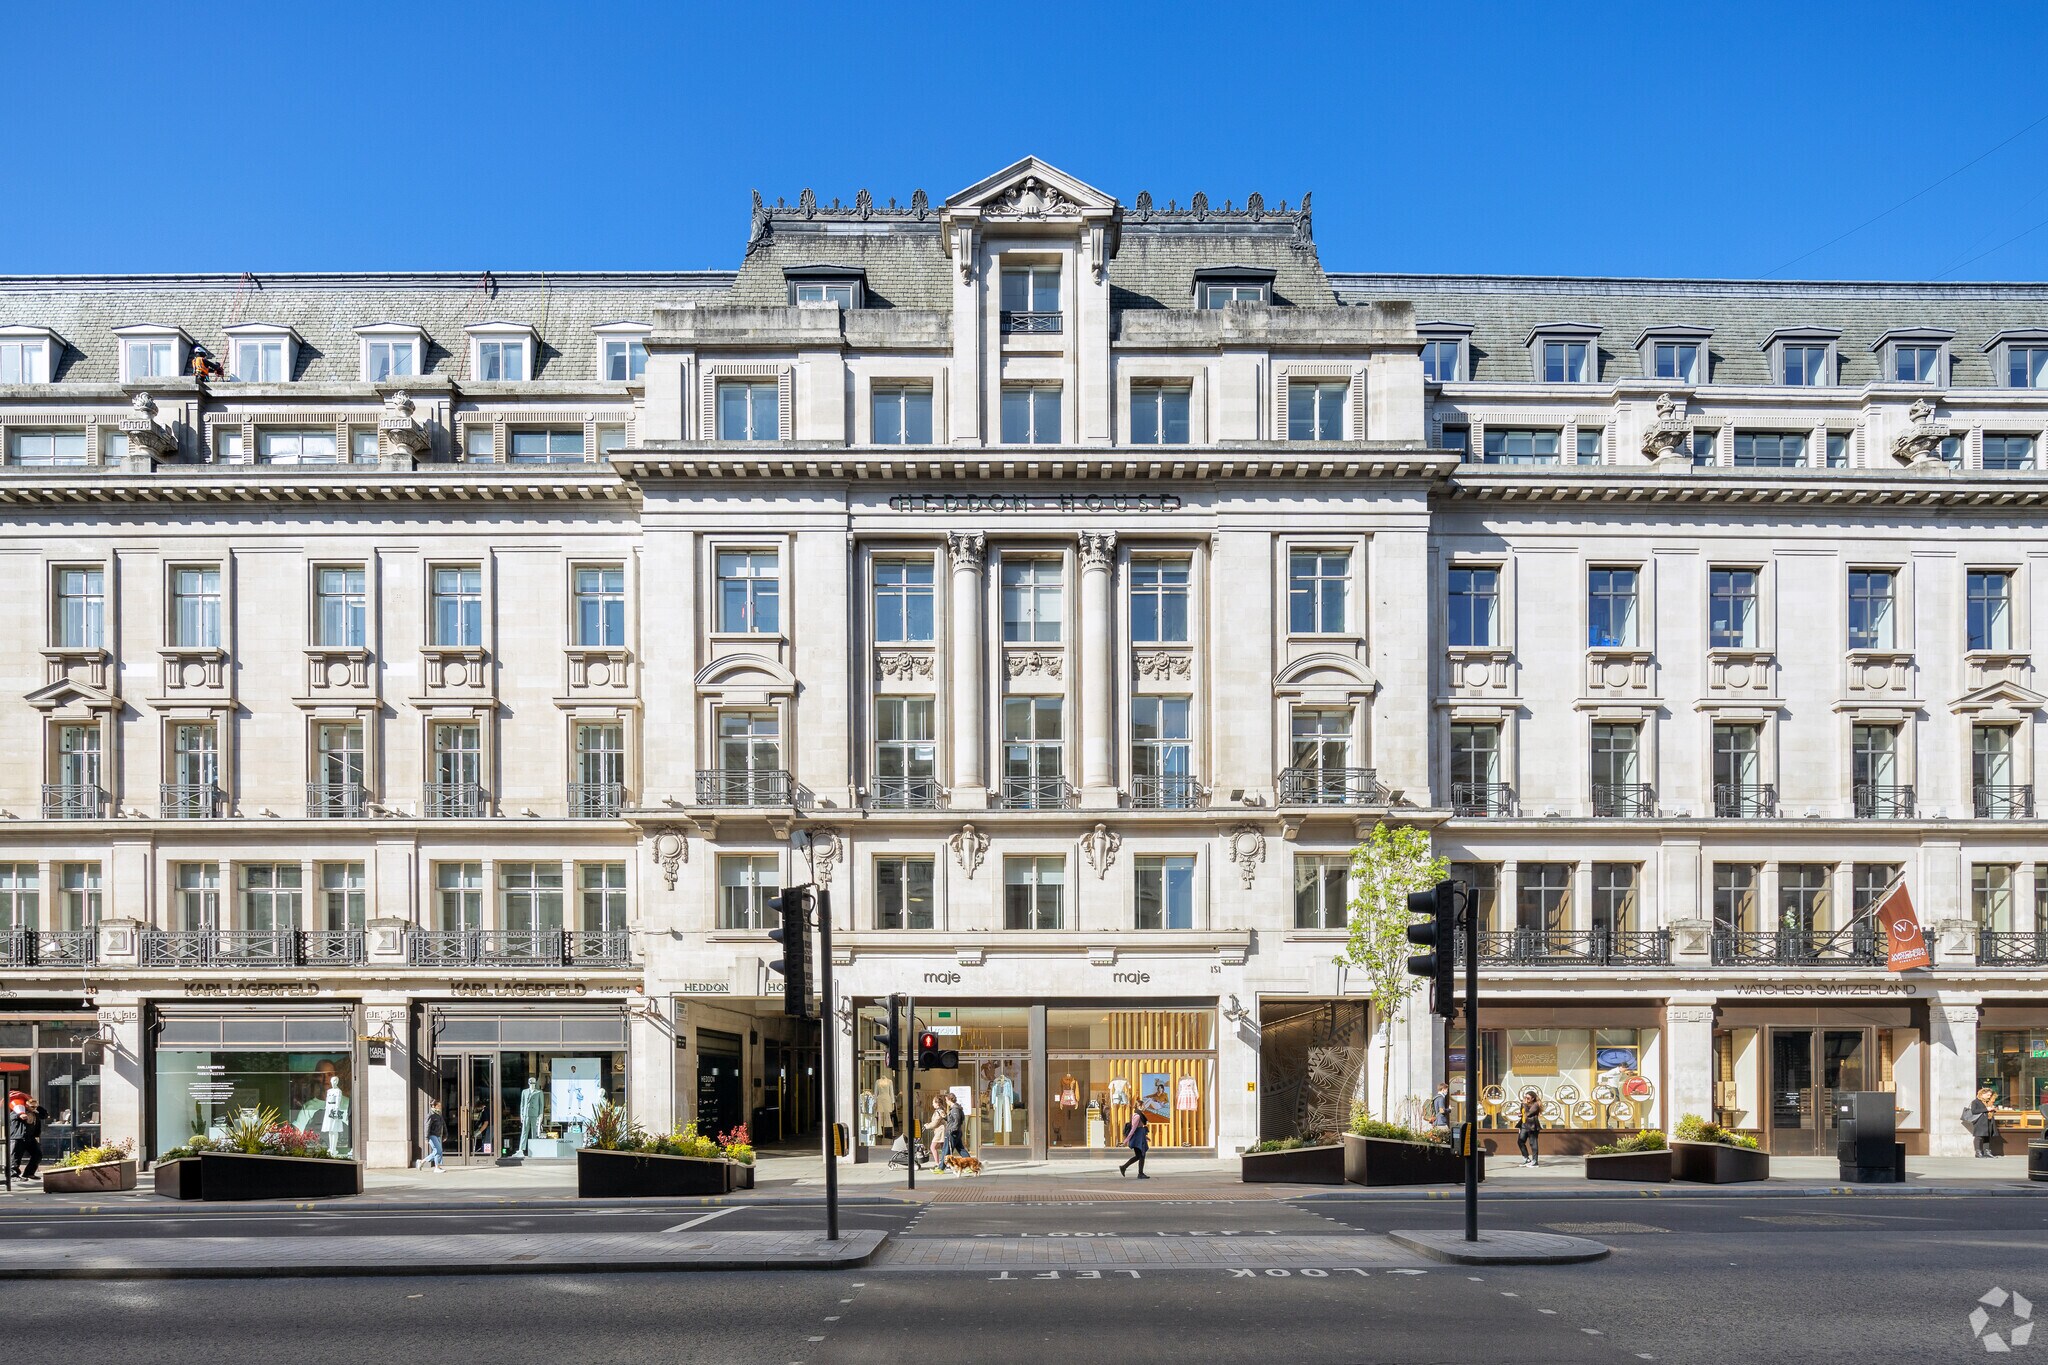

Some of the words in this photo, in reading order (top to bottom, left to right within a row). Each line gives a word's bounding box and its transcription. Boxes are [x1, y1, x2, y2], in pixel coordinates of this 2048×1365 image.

[898, 493, 1028, 512] HEDDON
[1060, 493, 1173, 512] HOUSE
[923, 970, 962, 985] maje
[1113, 970, 1151, 985] maje
[184, 983, 226, 997] KARL
[227, 983, 320, 997] LAGERFELD
[450, 983, 493, 997] KARL
[494, 983, 587, 997] LAGERFELD
[684, 982, 730, 992] HEDDON
[1734, 984, 1805, 996] WATCHES
[1816, 984, 1917, 996] SWITZERLAND
[369, 1046, 385, 1055] KARL
[987, 1269, 1142, 1280] LEFT
[1225, 1267, 1370, 1278] LOOK
